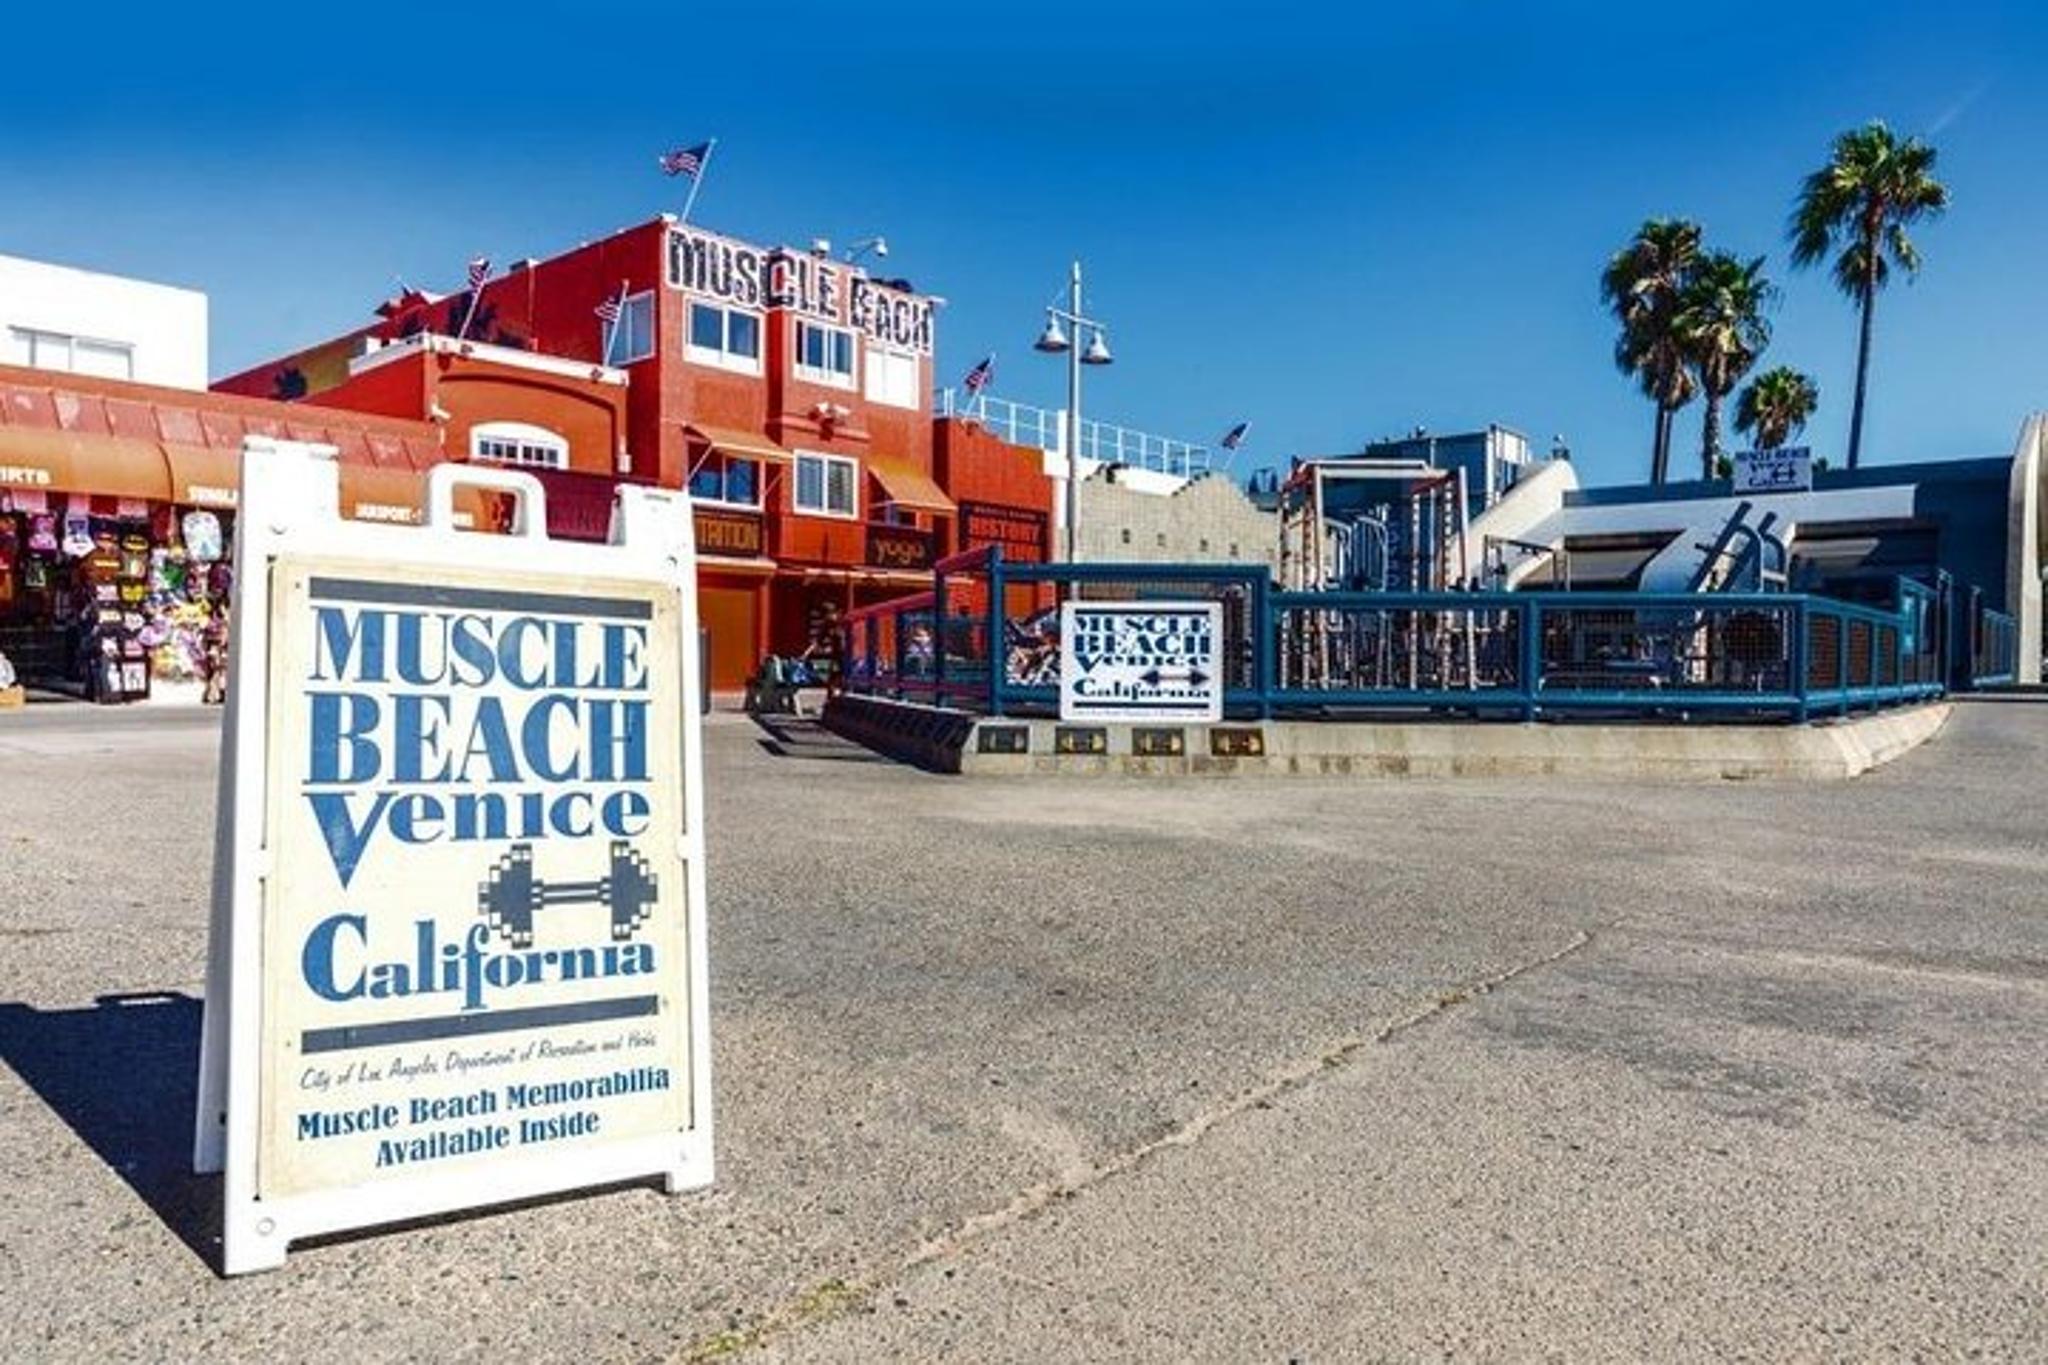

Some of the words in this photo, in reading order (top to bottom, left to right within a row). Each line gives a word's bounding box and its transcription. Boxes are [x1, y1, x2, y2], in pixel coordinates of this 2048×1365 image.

[669, 230, 836, 317] MUSCLE
[851, 277, 934, 352] BEACH
[0, 466, 50, 485] IRTS
[308, 605, 648, 691] MUSCLE
[1074, 616, 1211, 633] MUSCLE
[1074, 633, 1210, 654] BEACH
[1072, 678, 1211, 701] California
[1074, 654, 1210, 674] Venice
[302, 691, 653, 785] BEACH
[301, 789, 651, 891] Venice
[301, 912, 657, 1011] California
[300, 1066, 331, 1092] City
[336, 1062, 356, 1086] of
[519, 1041, 536, 1062] of
[297, 1103, 399, 1141] Muscle
[409, 1088, 497, 1125] Beach
[506, 1065, 670, 1110] Memorabilia
[375, 1125, 511, 1168] Available
[519, 1110, 601, 1144] Inside
